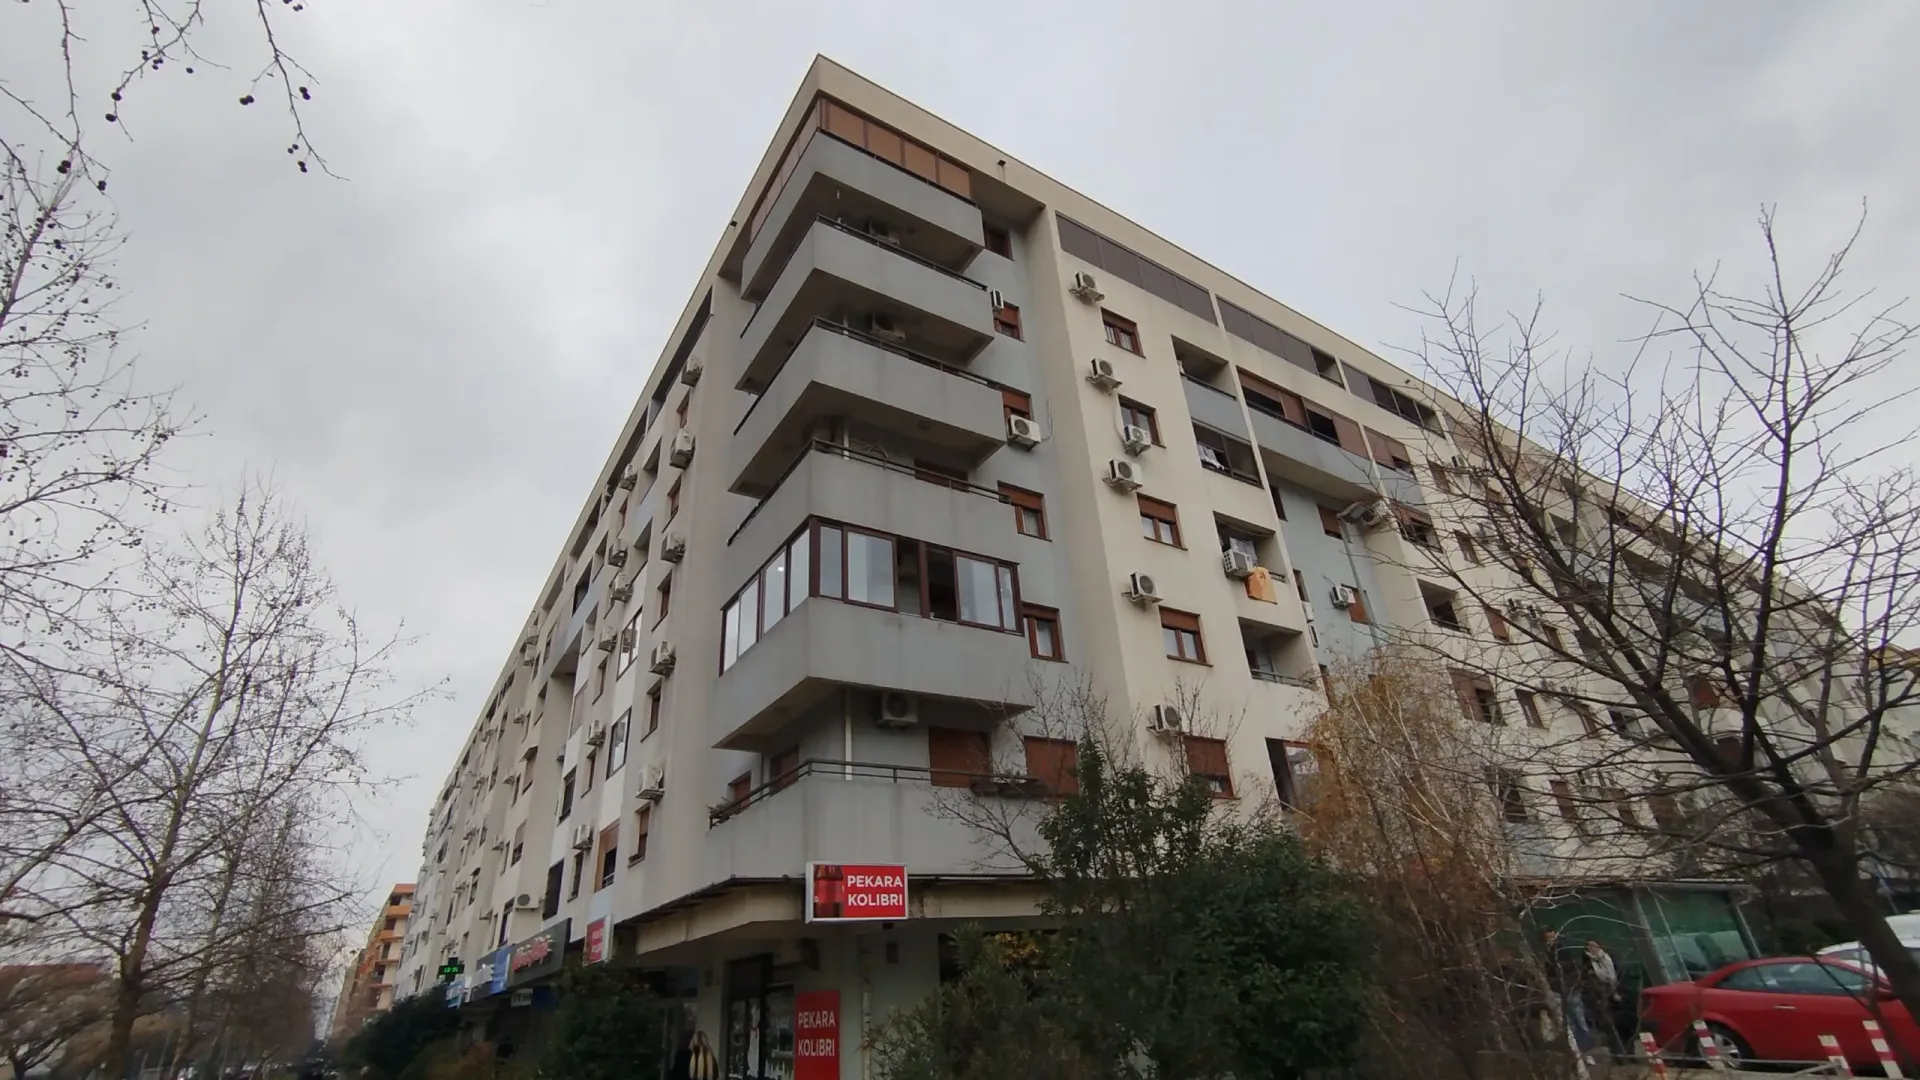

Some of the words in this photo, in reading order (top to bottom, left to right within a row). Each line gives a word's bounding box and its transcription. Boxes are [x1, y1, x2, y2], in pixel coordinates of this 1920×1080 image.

[847, 875, 903, 888] PEKARA
[847, 893, 903, 906] KOLIBRI
[798, 1010, 836, 1028] PEKARA
[798, 1038, 836, 1057] KOLIBRI
